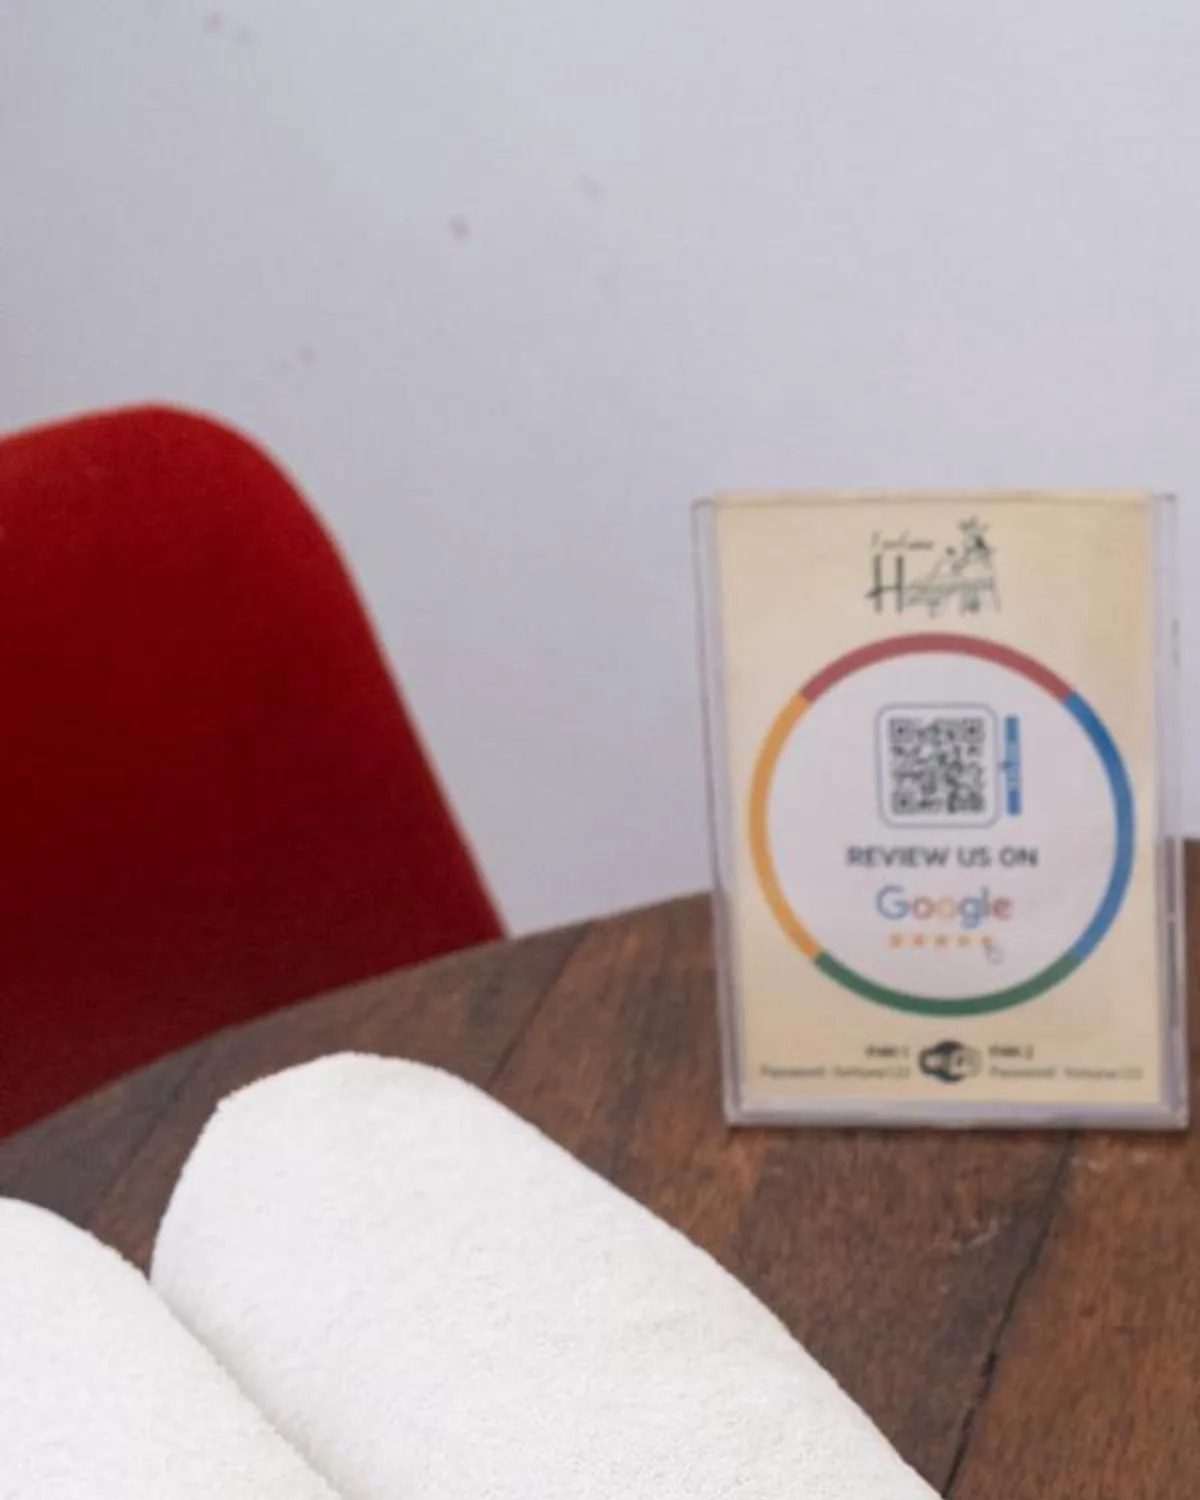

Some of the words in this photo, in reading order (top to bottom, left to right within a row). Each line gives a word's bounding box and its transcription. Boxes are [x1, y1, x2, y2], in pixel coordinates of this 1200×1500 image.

[847, 845, 949, 869] REVIEW
[956, 845, 992, 869] US
[999, 845, 1039, 869] ON
[875, 884, 1014, 930] Google
